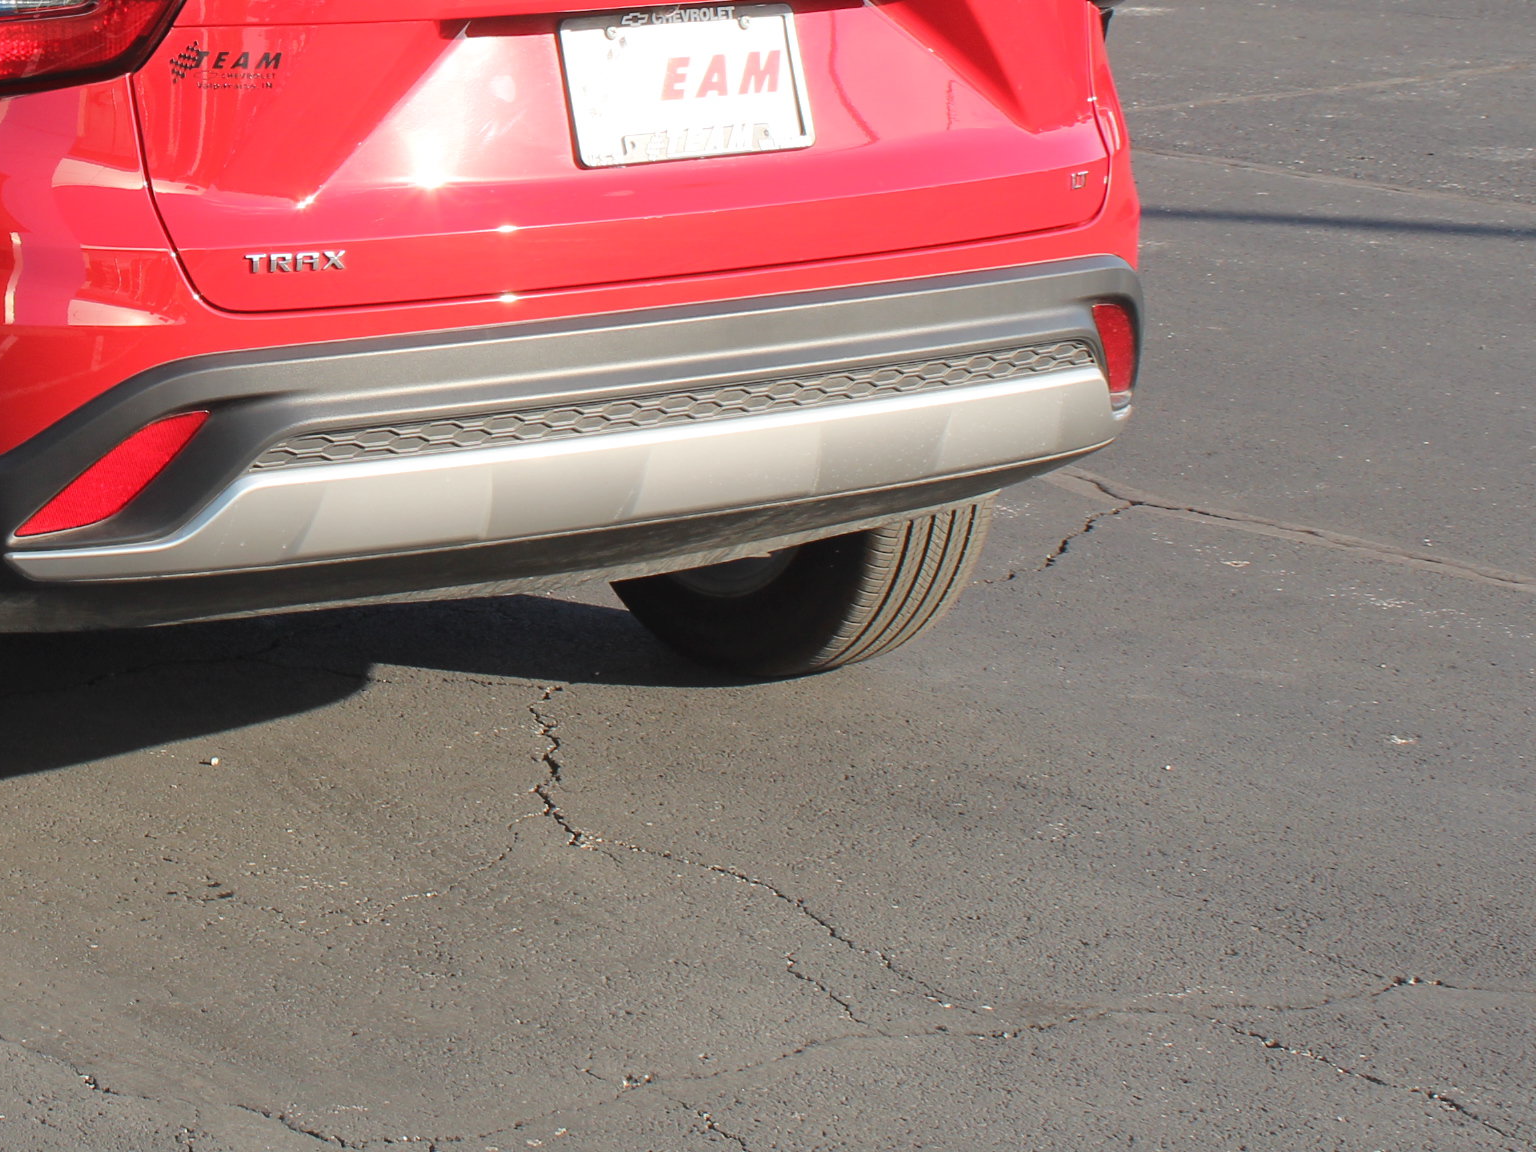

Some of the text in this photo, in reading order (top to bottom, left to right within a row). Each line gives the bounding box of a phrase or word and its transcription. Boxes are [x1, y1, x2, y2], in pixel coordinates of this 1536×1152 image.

[651, 5, 735, 25] CHEVROLET
[194, 51, 282, 70] TEAM
[244, 250, 346, 273] TRAX
